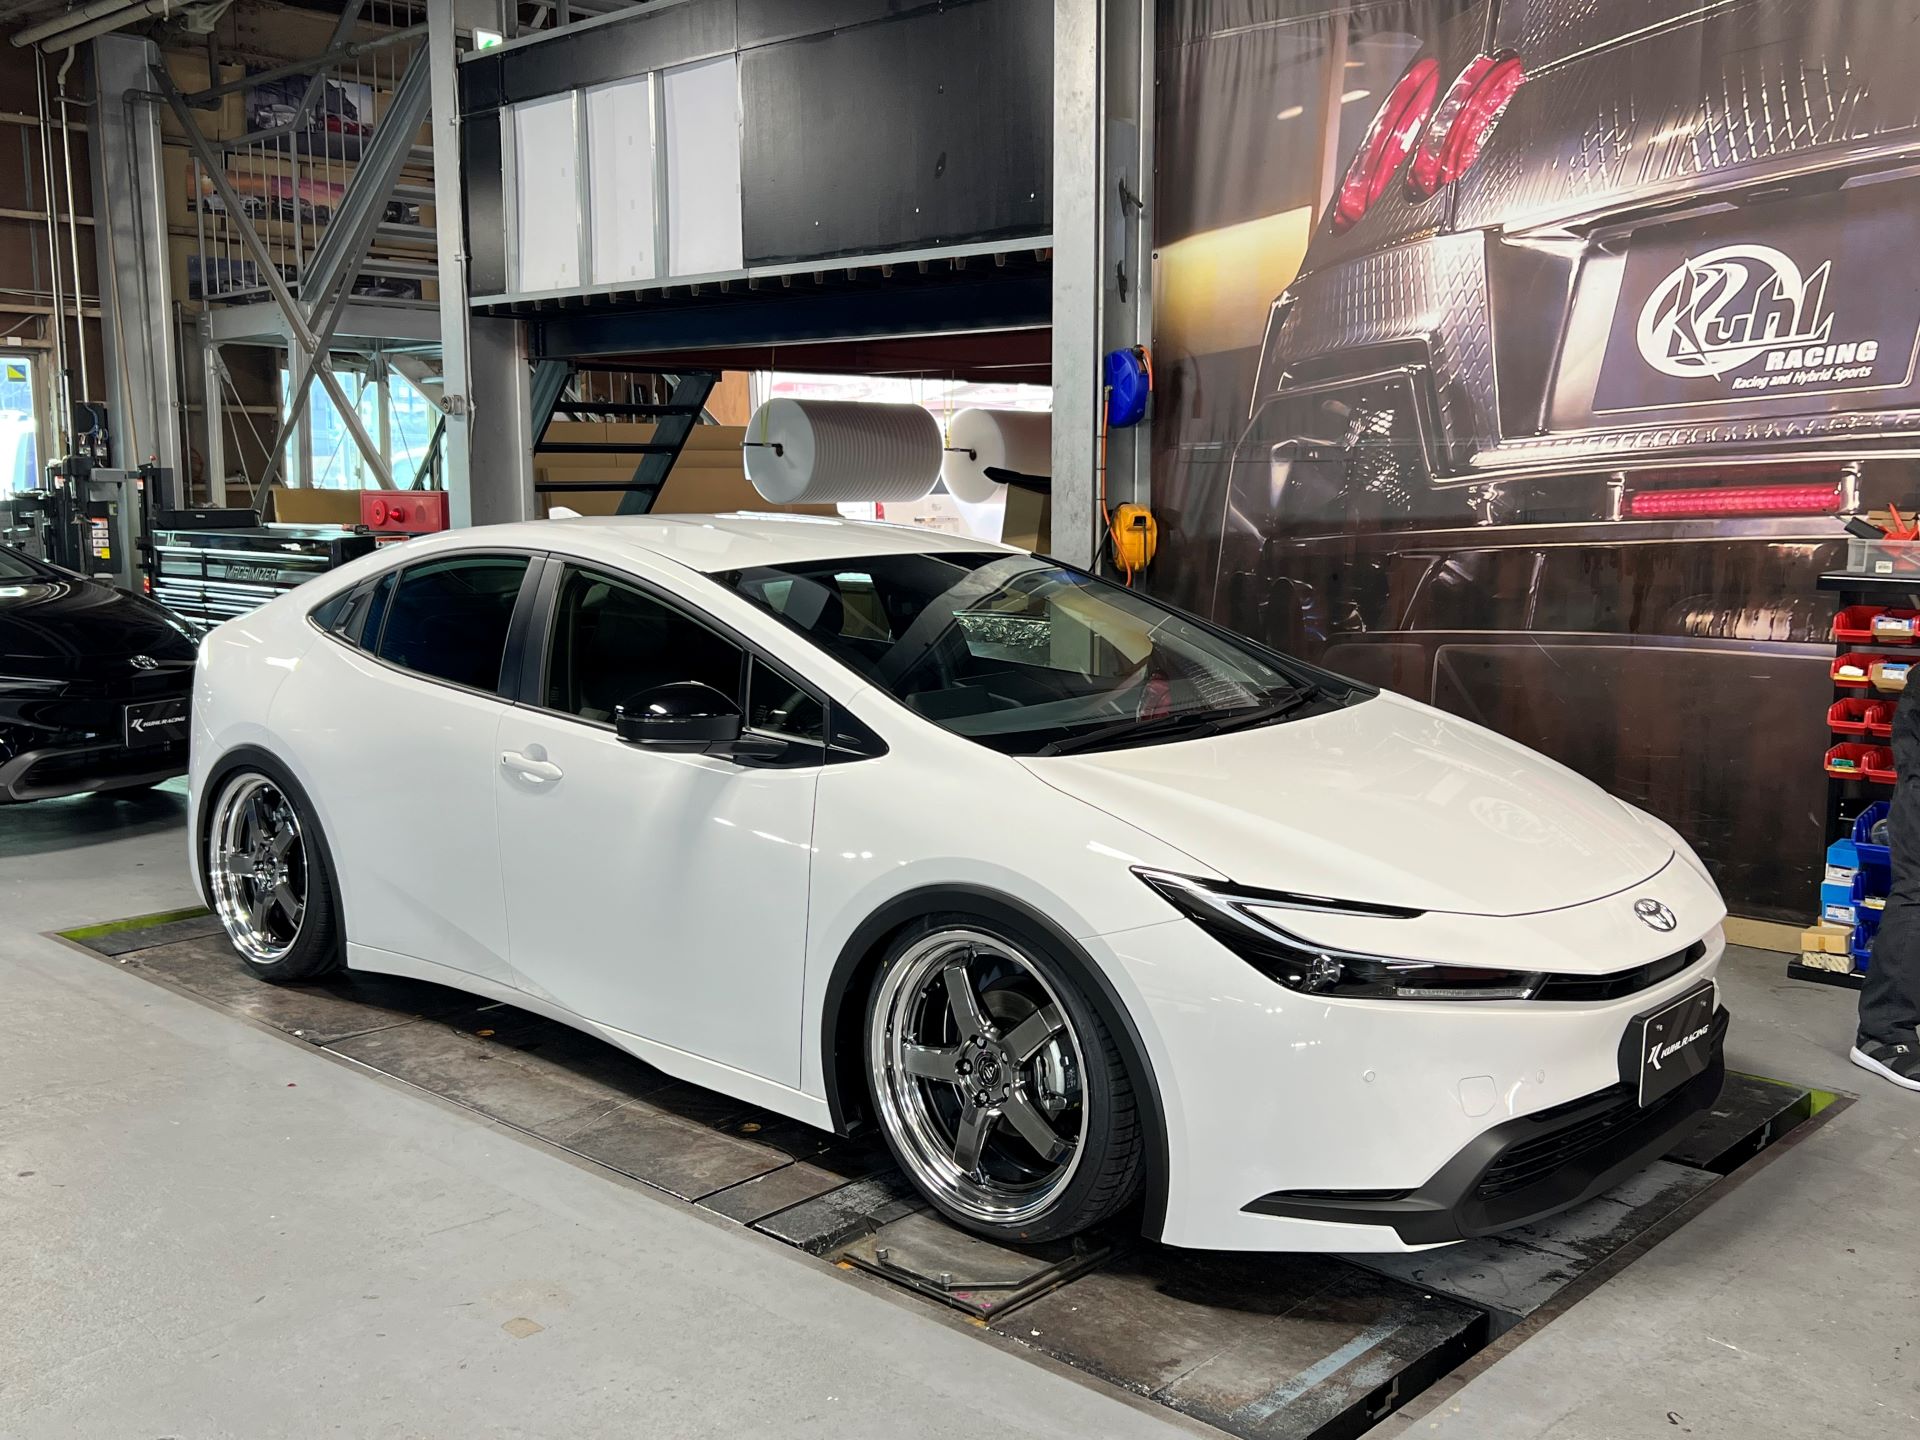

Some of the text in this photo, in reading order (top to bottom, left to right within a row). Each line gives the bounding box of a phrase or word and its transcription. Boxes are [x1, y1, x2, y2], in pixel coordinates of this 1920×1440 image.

[1765, 340, 1879, 371] RACING
[1732, 365, 1873, 390] Racing and Hybrid Sports
[1681, 1024, 1709, 1047] RACING
